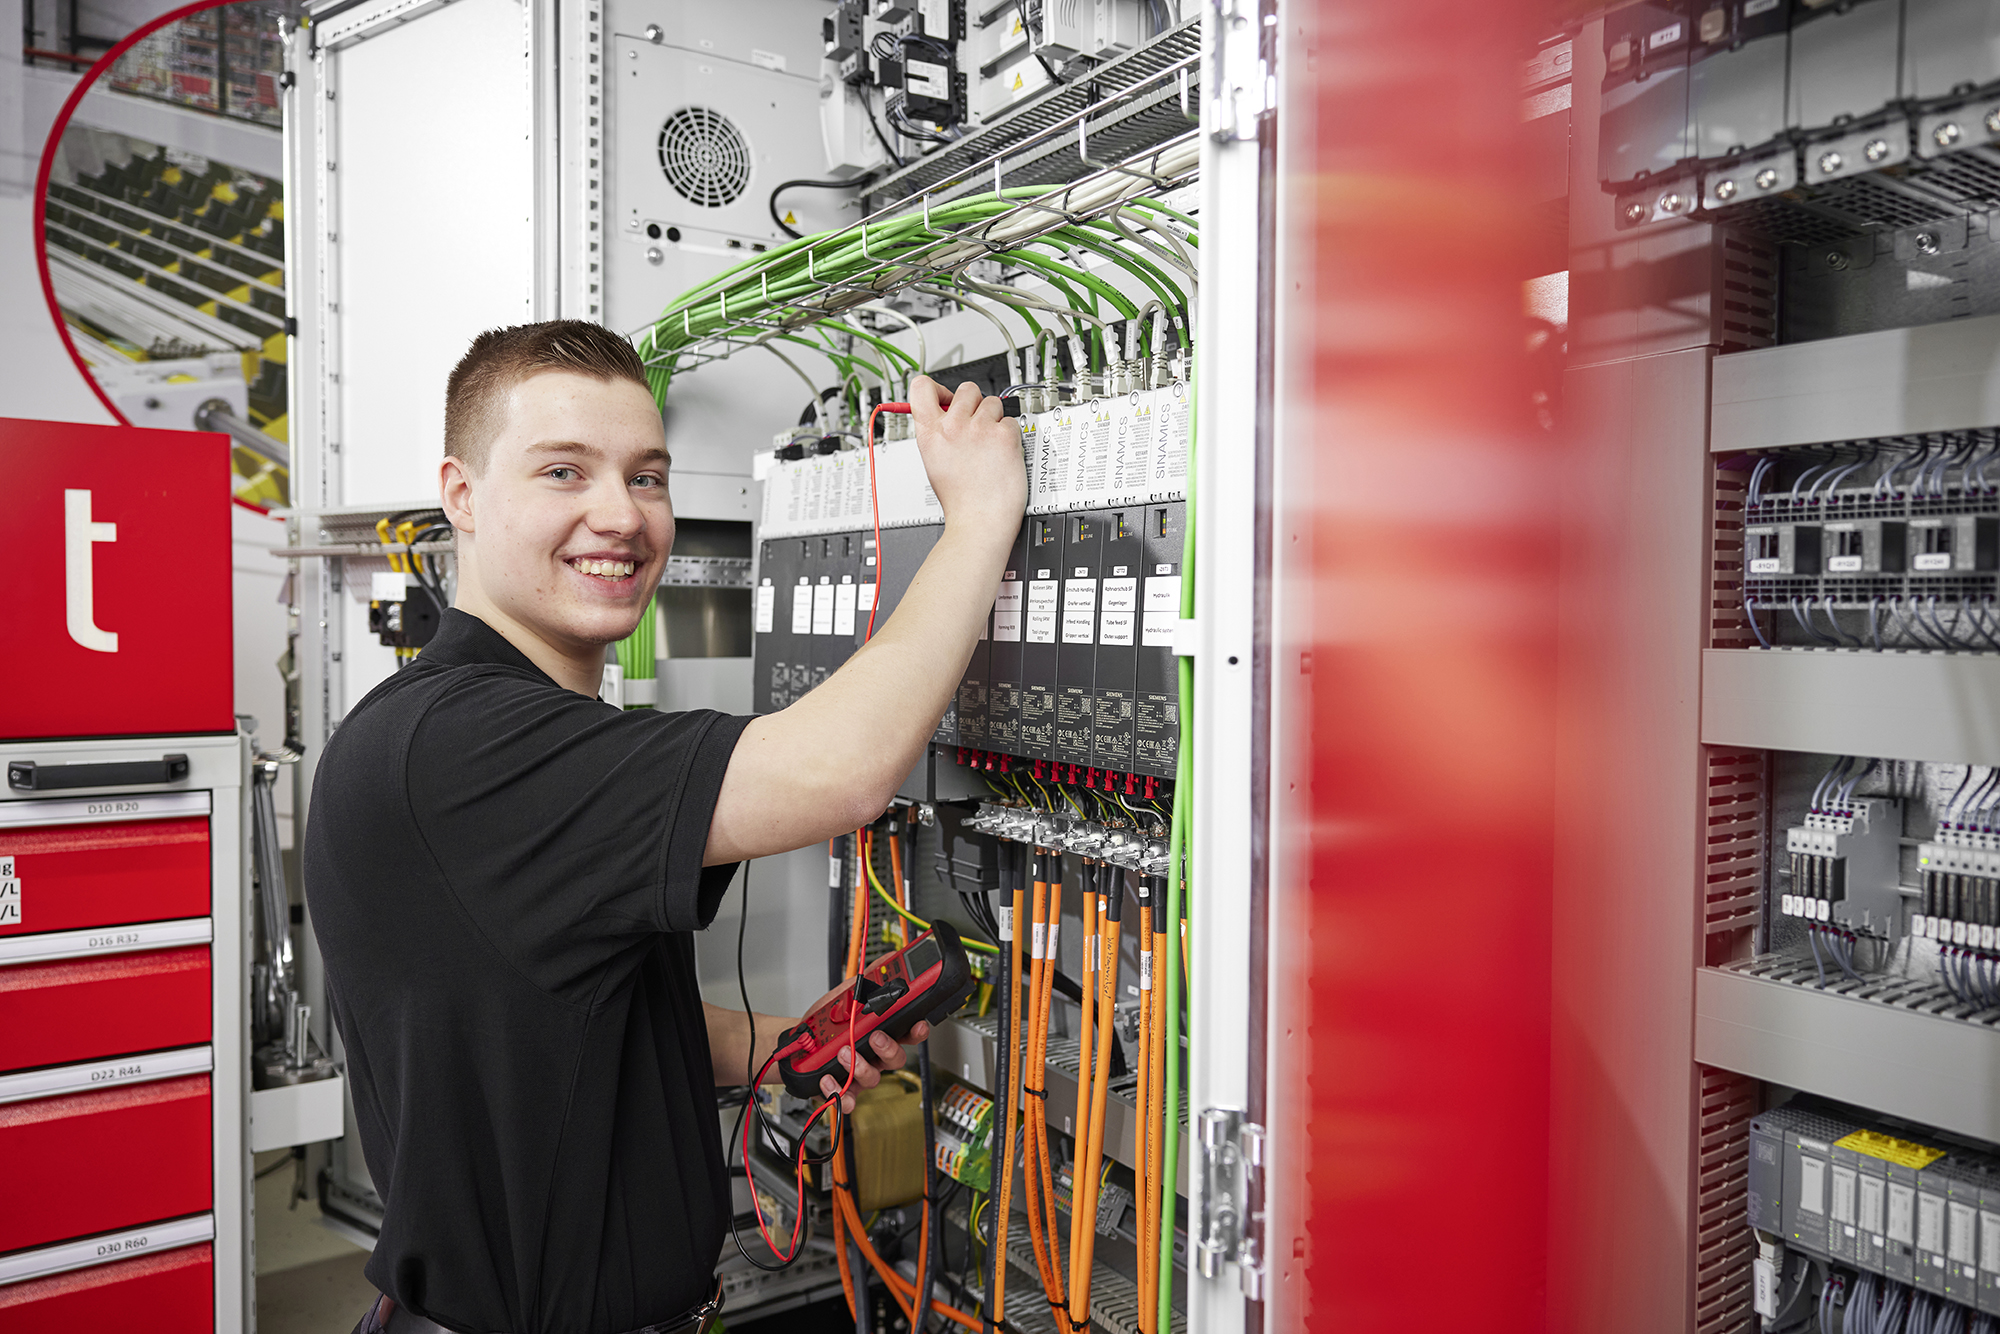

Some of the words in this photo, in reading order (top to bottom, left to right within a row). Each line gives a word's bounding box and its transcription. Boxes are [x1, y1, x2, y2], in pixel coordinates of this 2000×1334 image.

[1039, 426, 1051, 493] SINAMICS
[1076, 422, 1088, 492] SINAMICS
[1114, 416, 1128, 489] SINAMICS
[1156, 404, 1170, 479] SINAMICS
[65, 488, 118, 652] t
[88, 803, 112, 814] D10
[116, 802, 139, 812] R20
[89, 936, 113, 947] D16
[117, 934, 139, 944] R32
[91, 1070, 115, 1081] D22
[119, 1065, 142, 1077] R44
[97, 1242, 121, 1256] D30
[125, 1236, 148, 1249] R60
